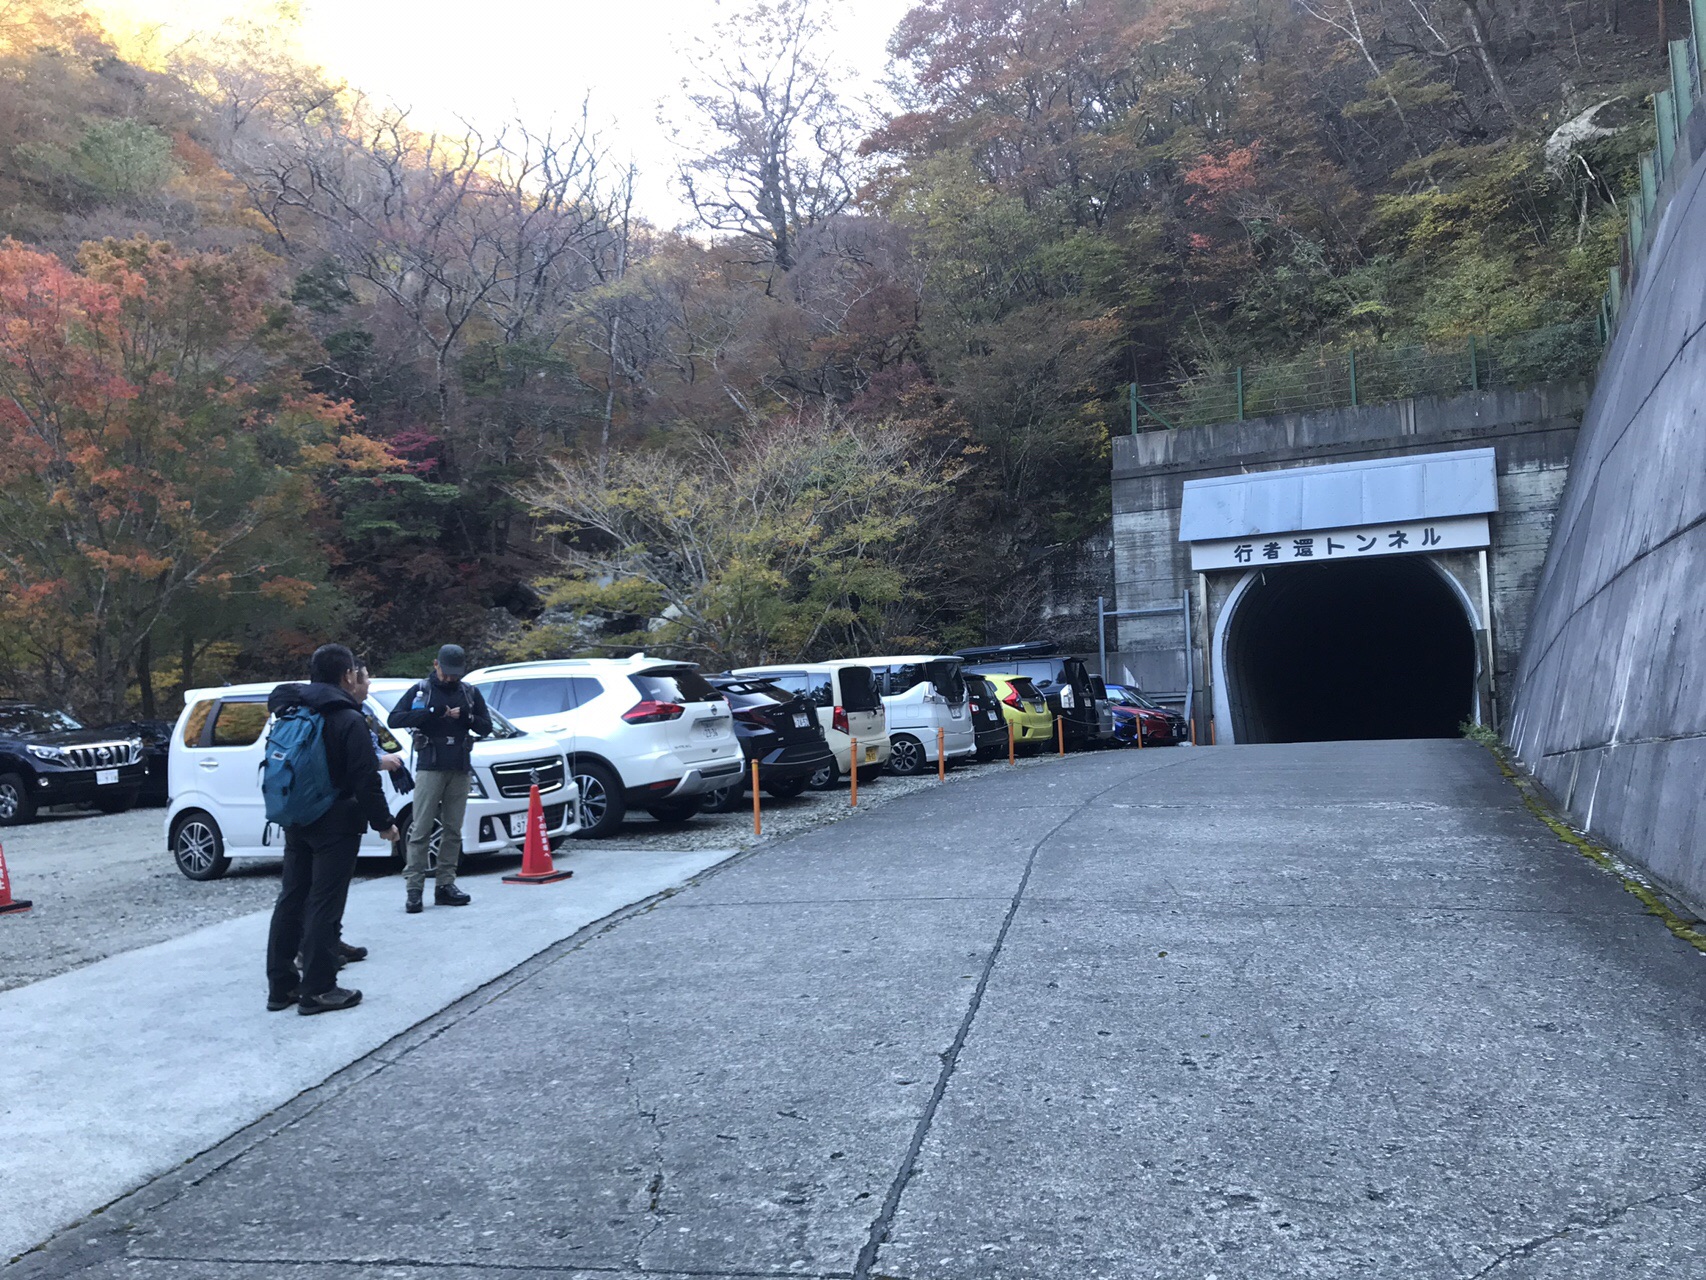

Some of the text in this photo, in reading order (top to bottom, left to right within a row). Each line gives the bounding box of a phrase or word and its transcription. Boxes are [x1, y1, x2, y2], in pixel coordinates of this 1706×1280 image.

[1234, 527, 1442, 563] 行者還トンネル
